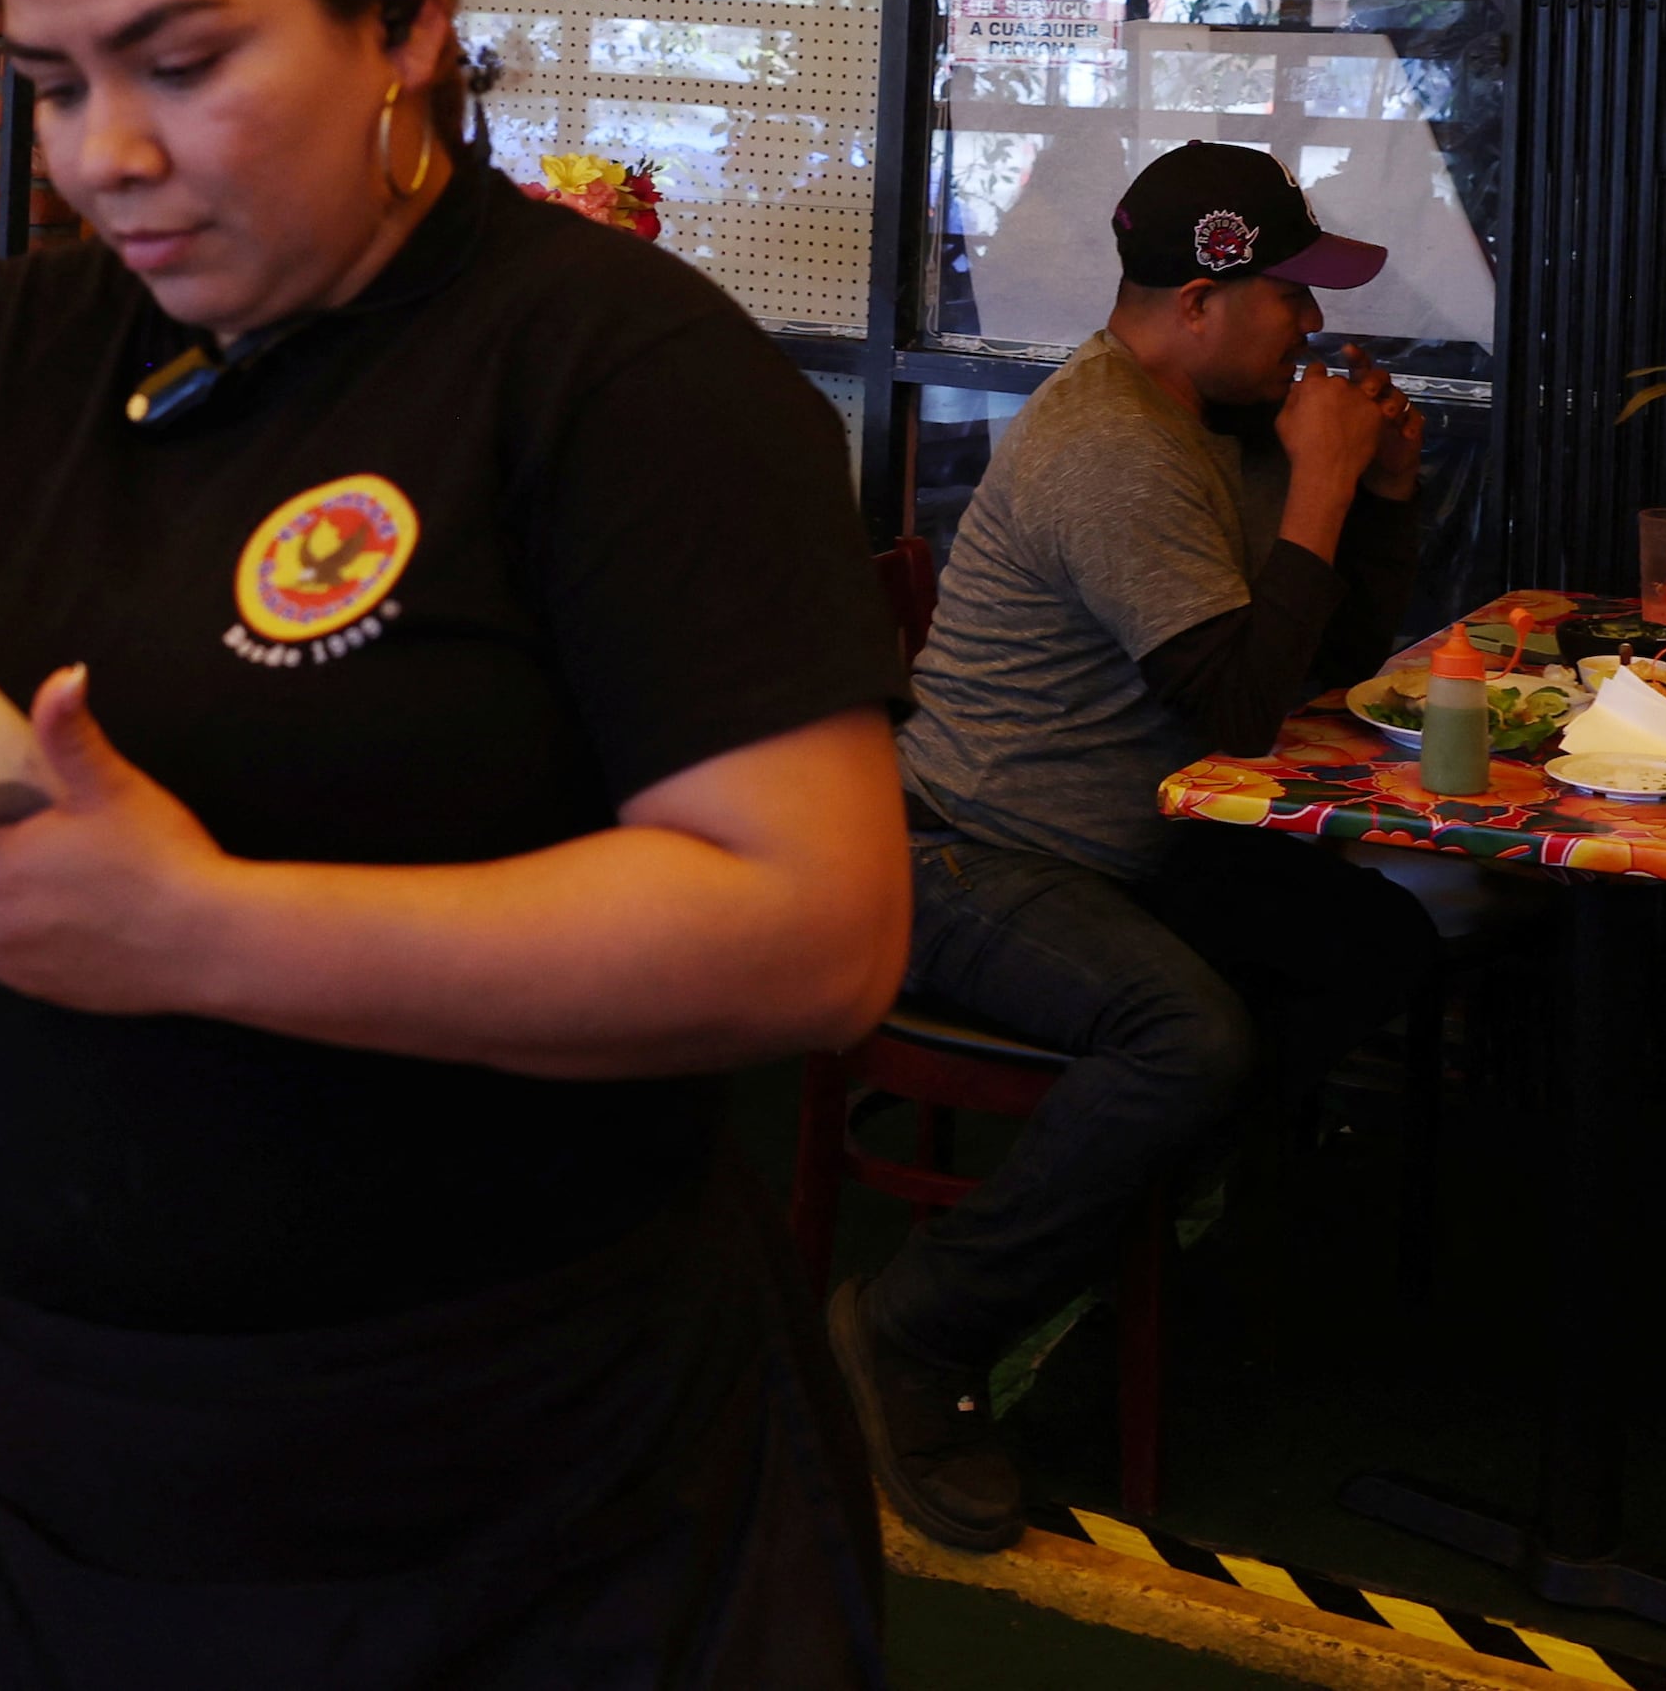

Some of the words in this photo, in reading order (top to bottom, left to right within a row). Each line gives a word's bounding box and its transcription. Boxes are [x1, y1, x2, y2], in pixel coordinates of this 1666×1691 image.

[1004, 0, 1096, 16] SERVICIO
[970, 22, 982, 36] A
[989, 22, 1098, 38] CUALQUIER
